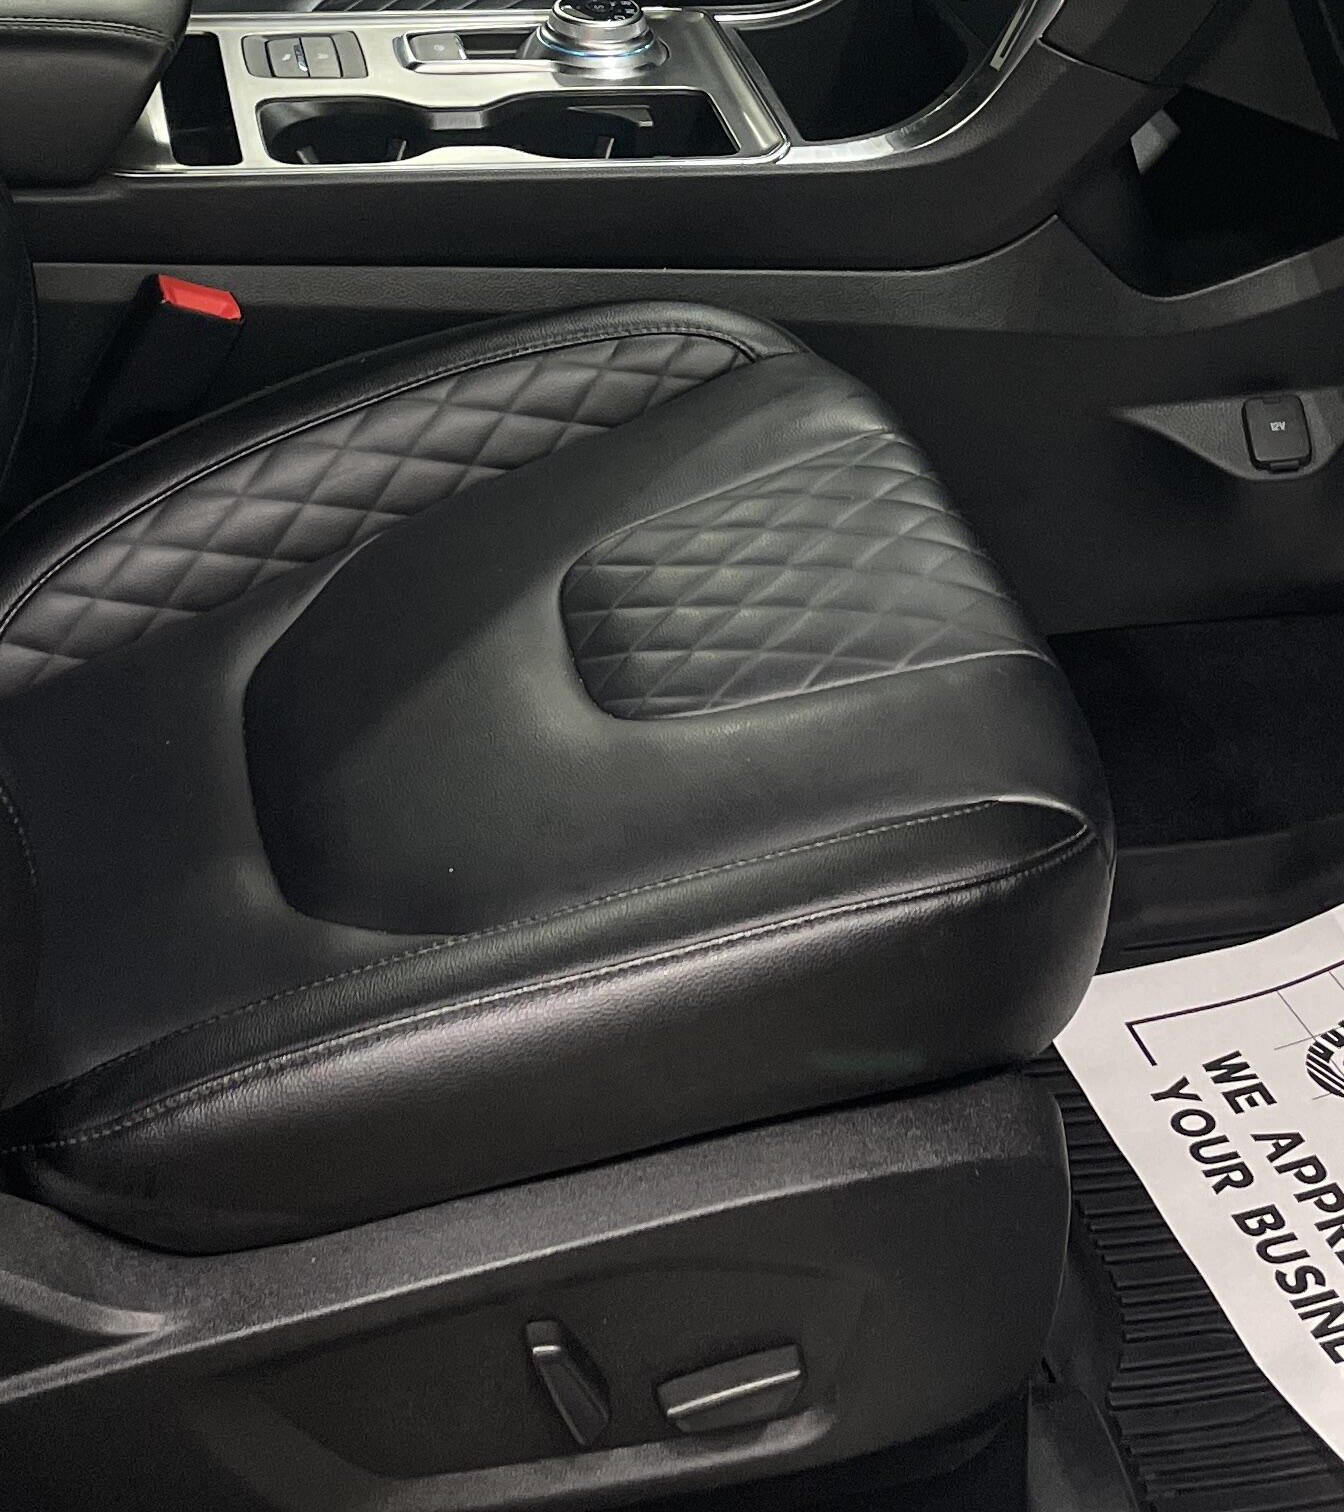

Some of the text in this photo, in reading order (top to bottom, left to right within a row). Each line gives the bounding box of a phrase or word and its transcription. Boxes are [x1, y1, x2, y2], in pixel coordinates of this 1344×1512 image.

[1270, 421, 1286, 432] 12V
[1202, 1050, 1278, 1115] WE
[1150, 1076, 1254, 1195] YOUR
